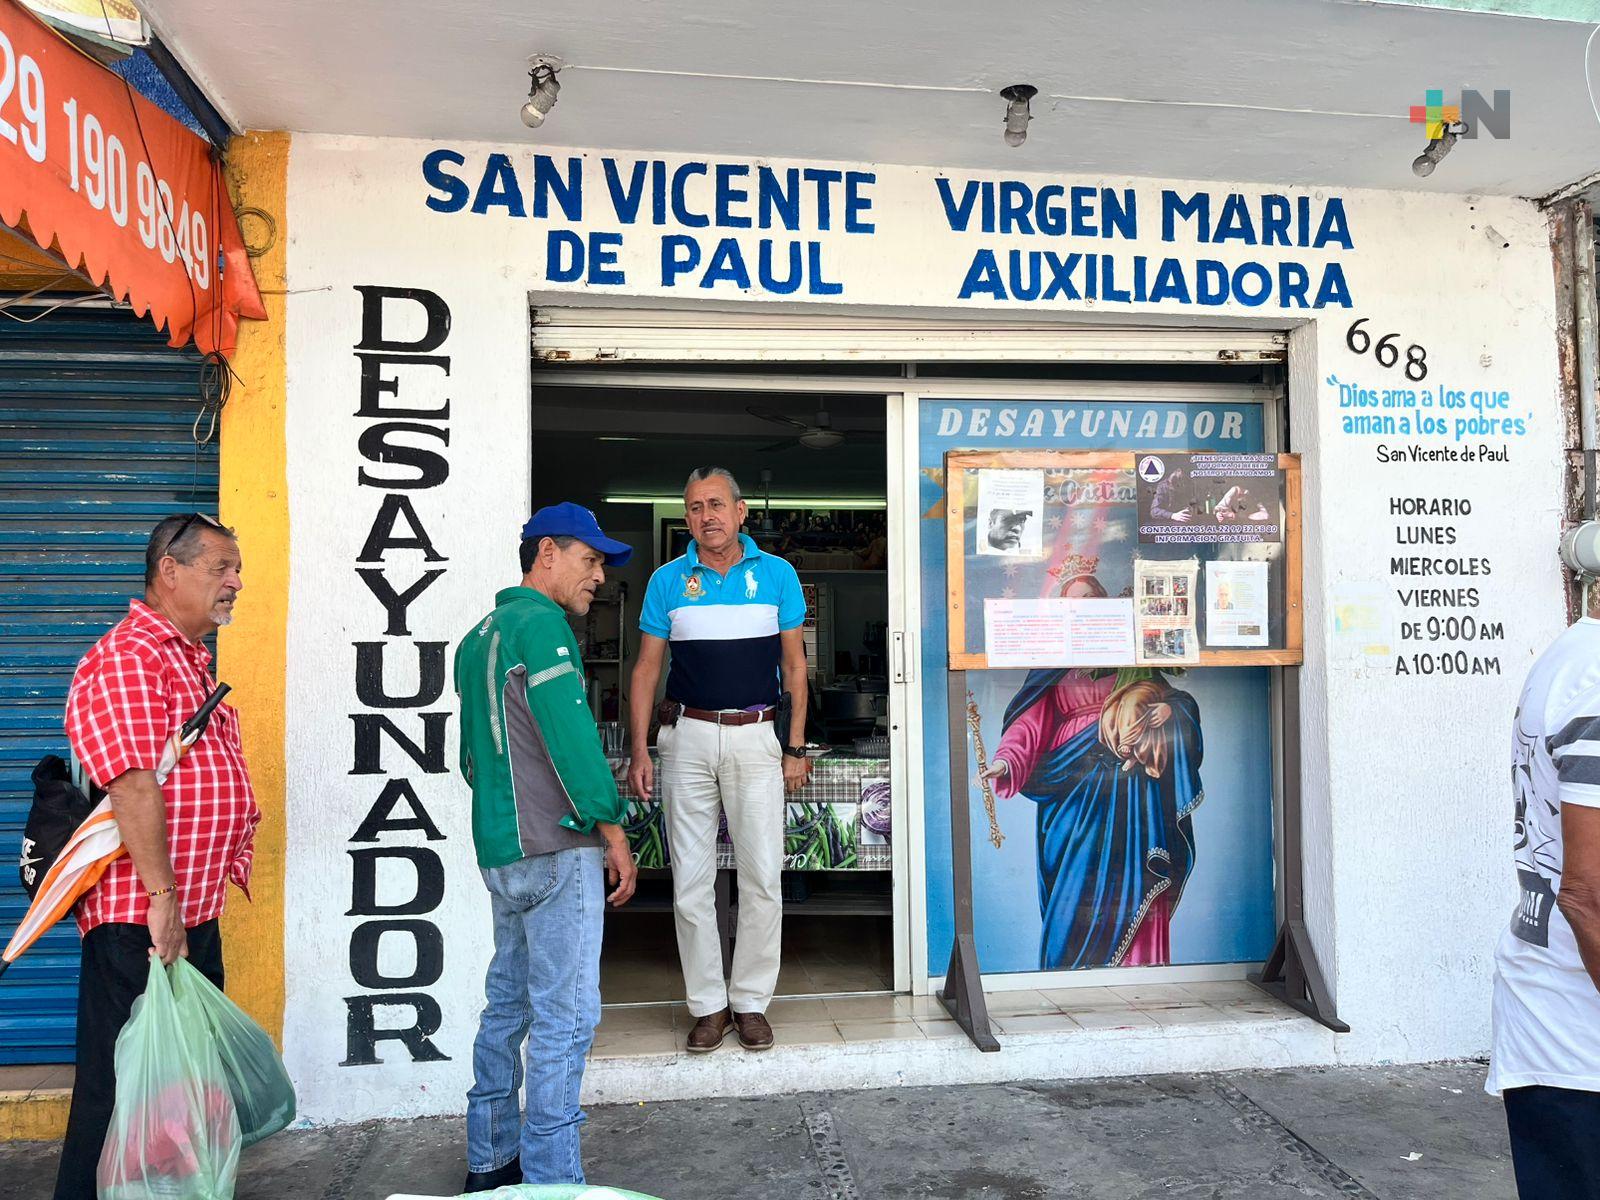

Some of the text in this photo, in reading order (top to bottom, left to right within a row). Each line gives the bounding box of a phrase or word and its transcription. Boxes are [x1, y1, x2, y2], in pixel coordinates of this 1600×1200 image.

[63, 97, 128, 227] 190
[136, 161, 209, 290] 9849
[423, 149, 876, 234] SAN VICENTE
[935, 178, 1354, 249] VIRGEN MARIA
[546, 230, 843, 295] DE PAUL
[957, 249, 1353, 308] AUXILIADORA
[1346, 318, 1428, 381] 668
[1382, 389, 1416, 408] ama
[1421, 390, 1433, 407] a
[1439, 384, 1466, 409] los
[1470, 391, 1510, 414] que
[936, 407, 1243, 440] DESAYUNADOR
[1342, 415, 1396, 434] aman
[1398, 416, 1411, 435] a
[1415, 409, 1448, 435] los
[1376, 444, 1510, 463] San Vicente de Paul
[1389, 497, 1472, 516] HORARIO
[1140, 526, 1205, 534] CONTACTANOS
[1396, 526, 1457, 545] LUNES
[1390, 557, 1491, 576] MIERCOLES
[1397, 588, 1480, 608] VIERNES
[1401, 615, 1505, 641] DE 9:00 AM
[338, 285, 452, 1067] DESAYUNADOR
[1395, 650, 1501, 676] A 10:00 AM
[24, 864, 37, 886] SB
